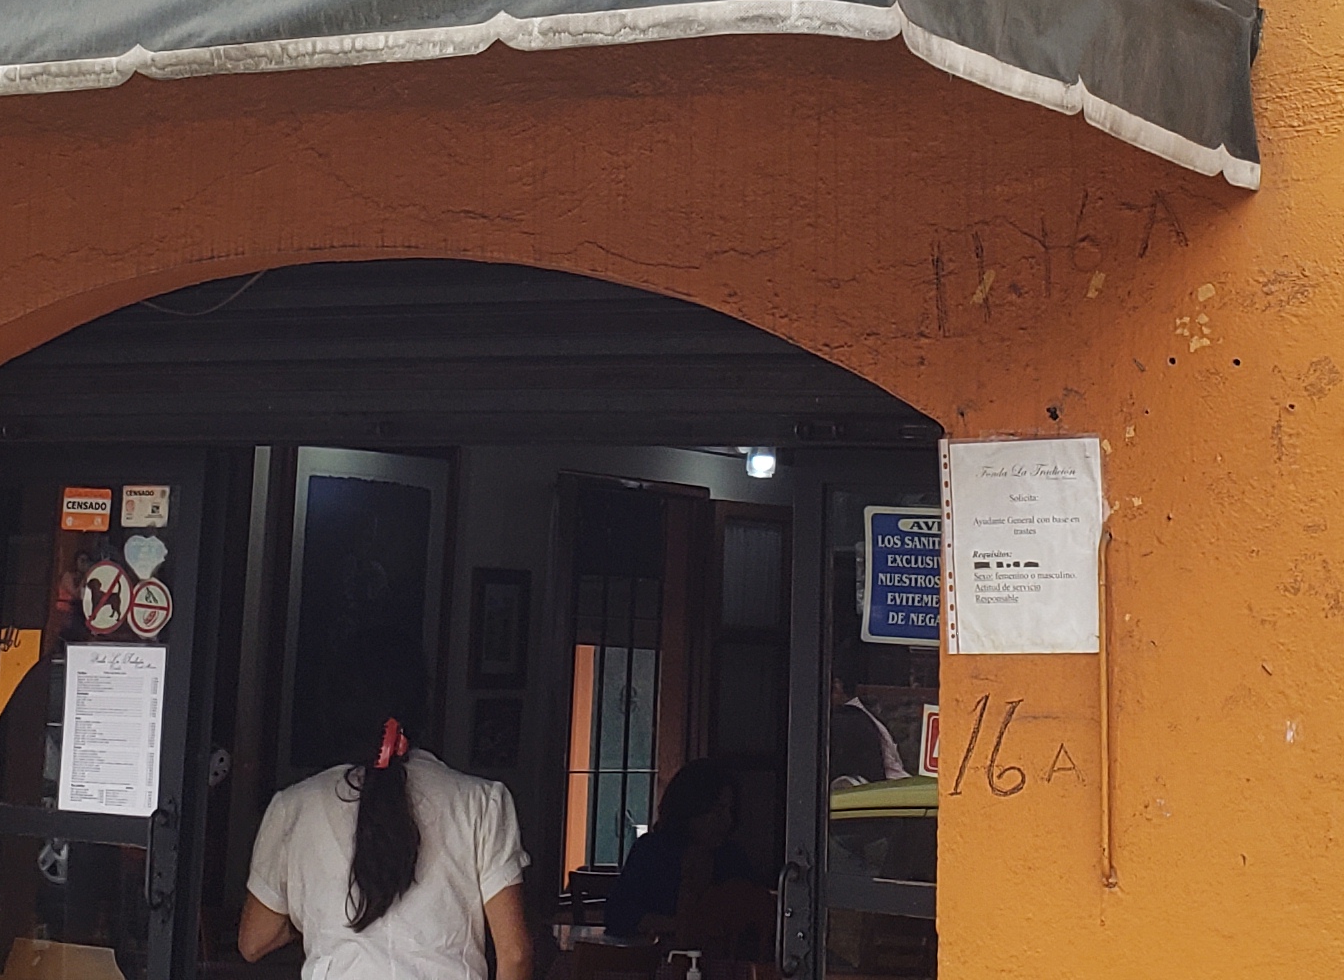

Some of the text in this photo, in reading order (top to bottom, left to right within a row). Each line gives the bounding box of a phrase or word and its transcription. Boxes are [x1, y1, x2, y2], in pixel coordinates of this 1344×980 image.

[66, 500, 107, 511] CENSADO
[878, 535, 901, 548] LOS
[888, 612, 905, 625] DE
[949, 693, 1026, 797] 16
